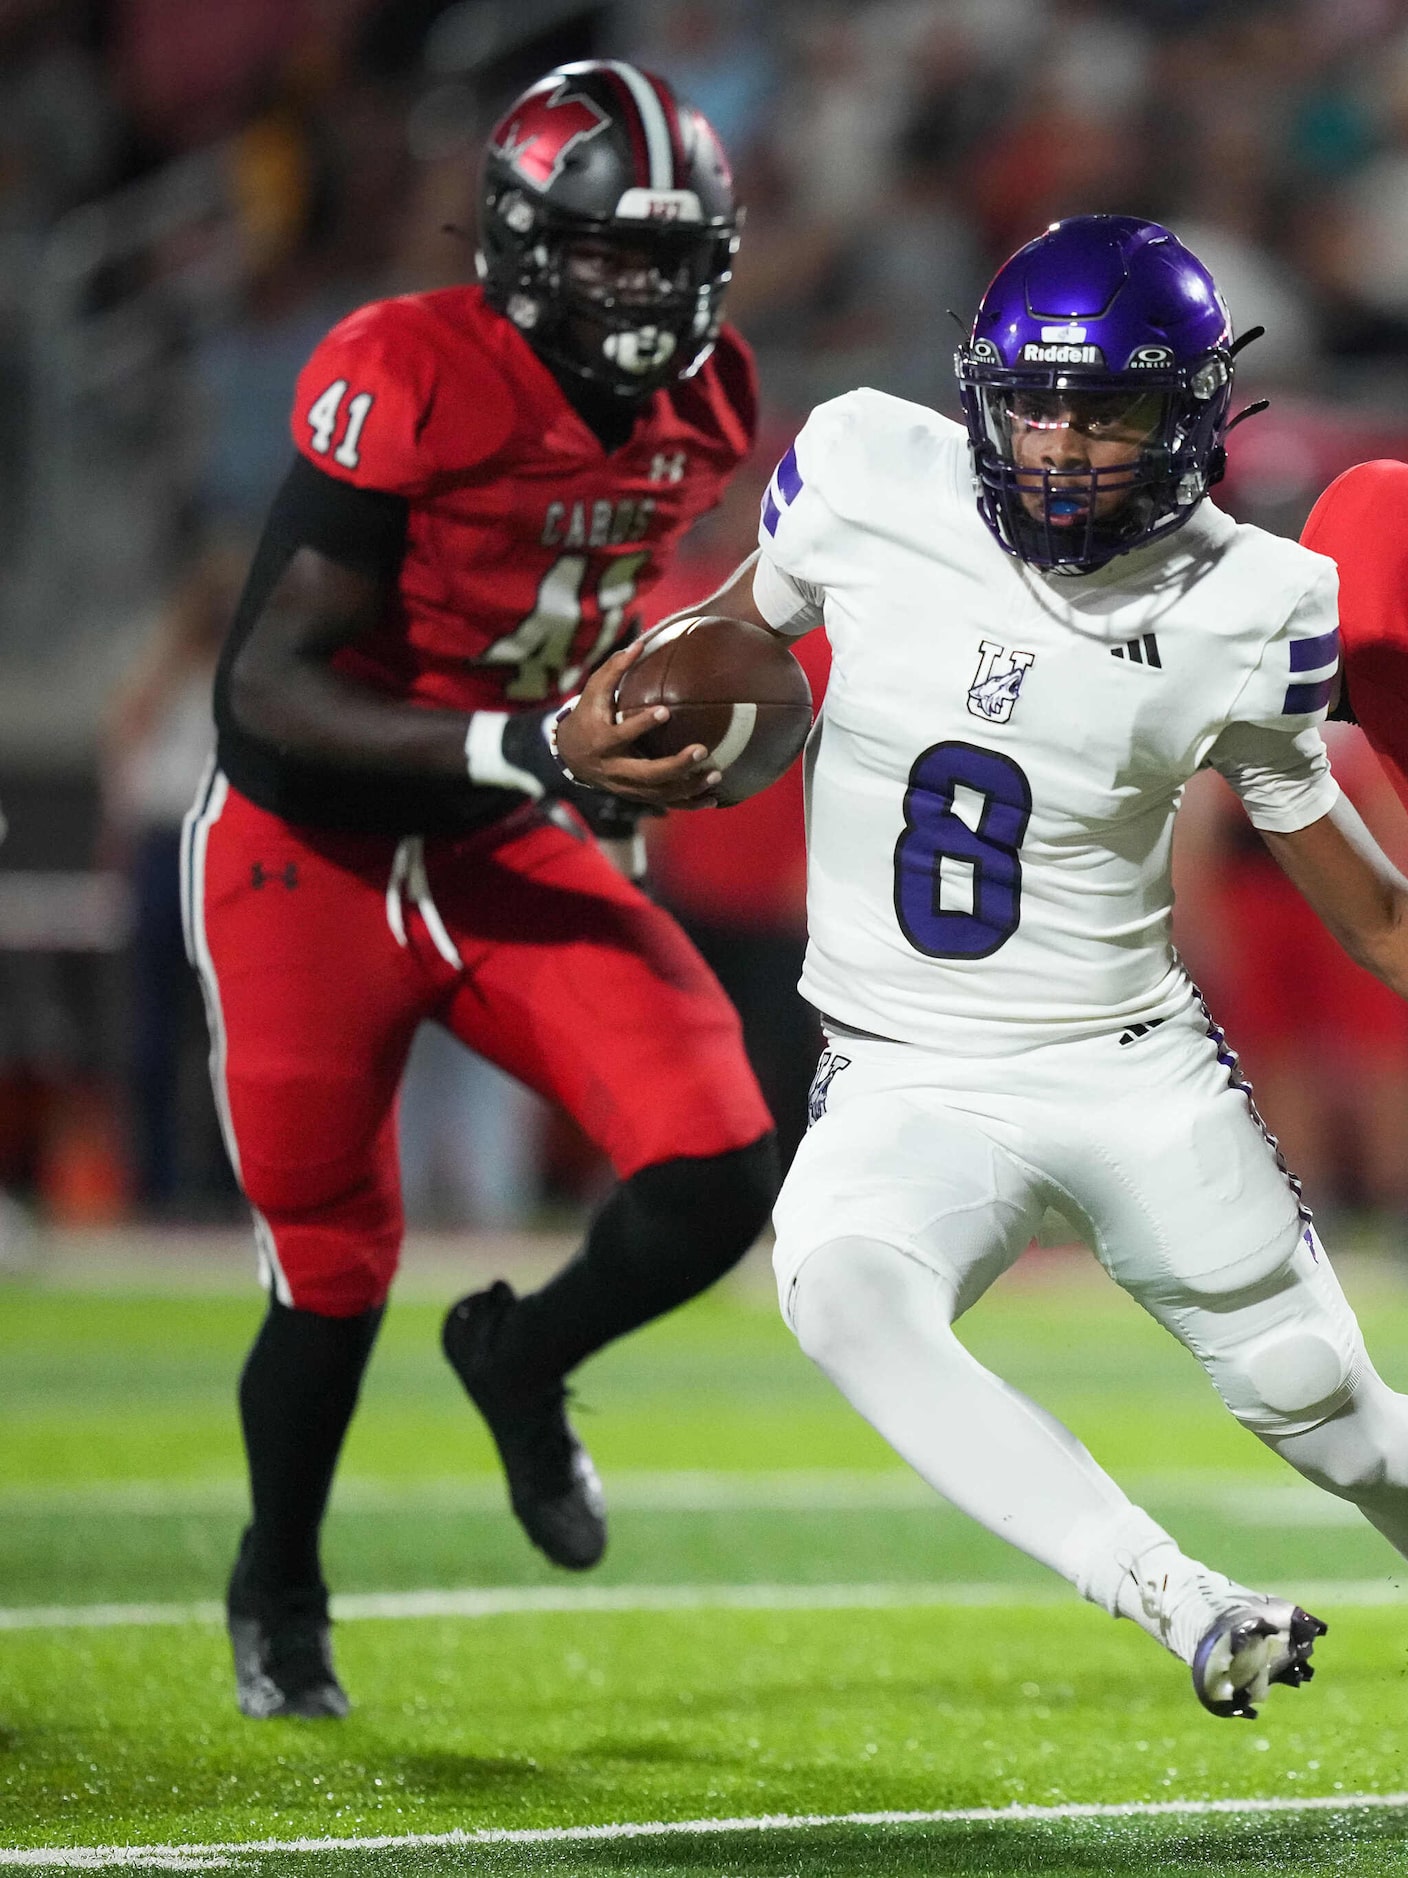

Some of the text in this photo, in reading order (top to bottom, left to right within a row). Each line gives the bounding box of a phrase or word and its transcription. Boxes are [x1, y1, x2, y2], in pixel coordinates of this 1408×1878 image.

[1023, 343, 1097, 364] Riddell
[305, 377, 375, 469] 41
[893, 740, 1033, 961] 8
